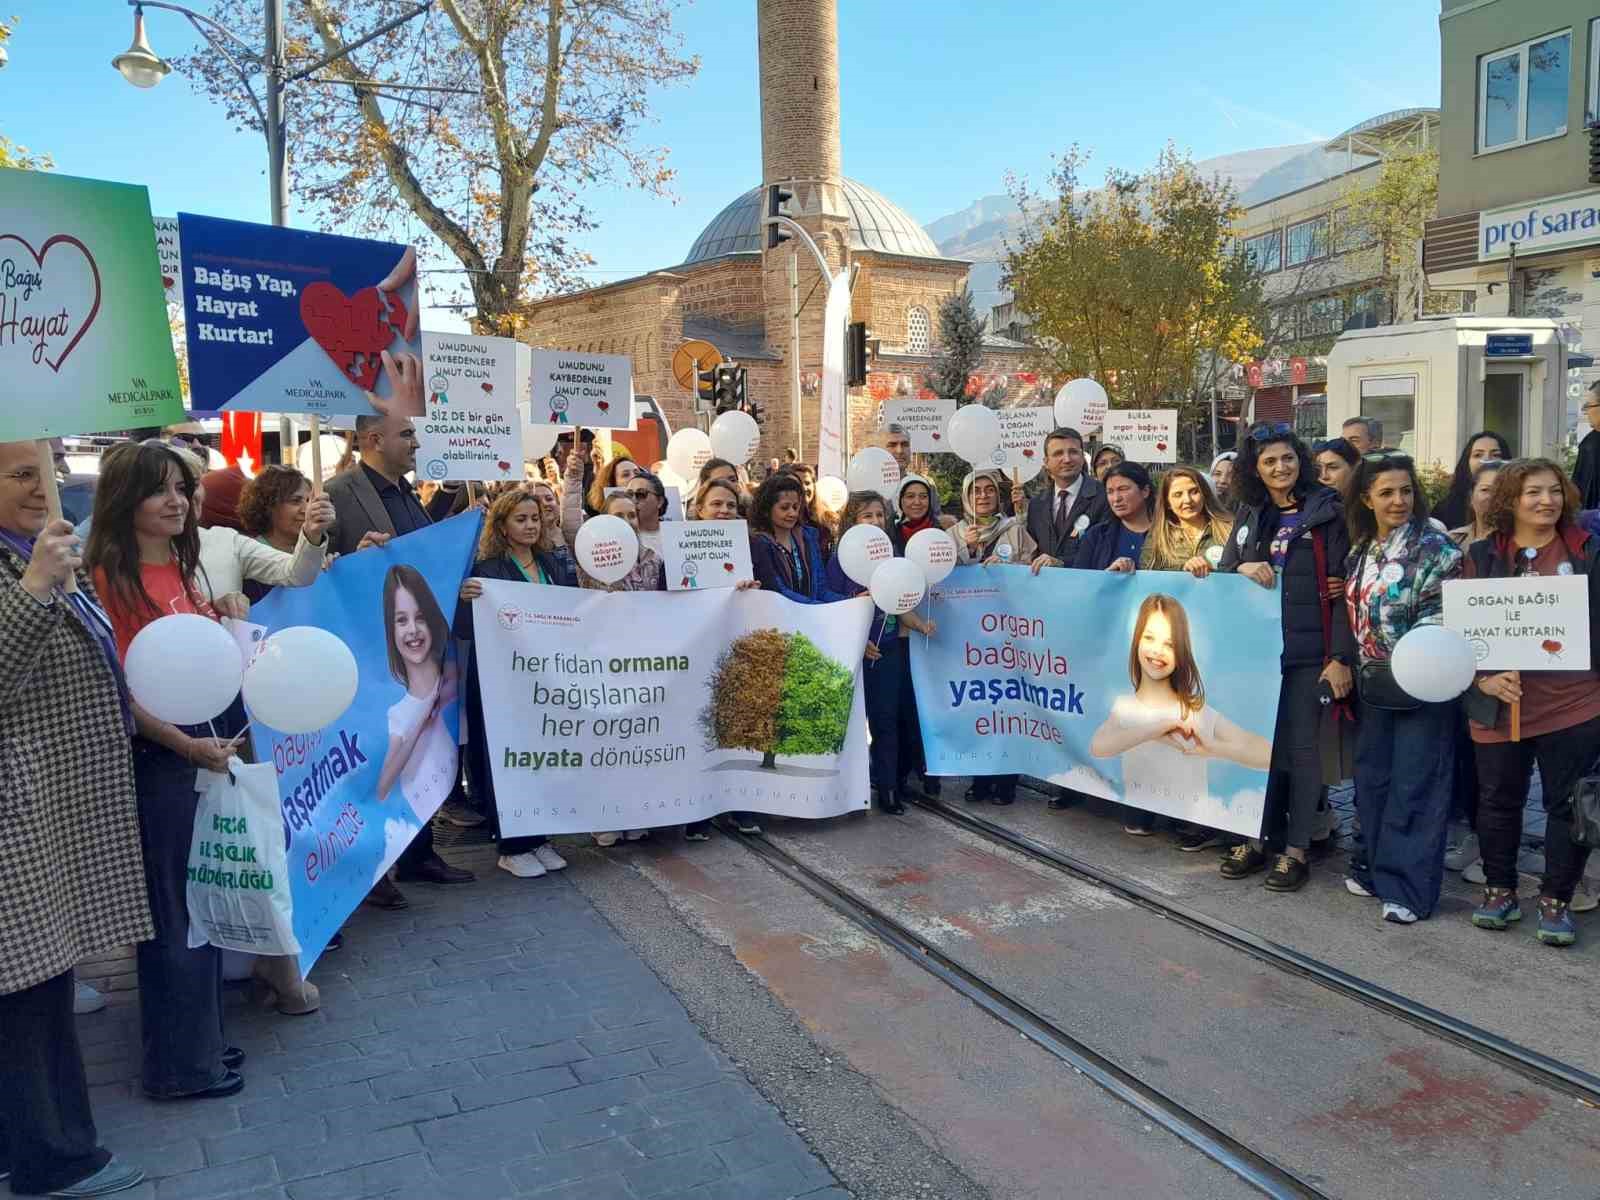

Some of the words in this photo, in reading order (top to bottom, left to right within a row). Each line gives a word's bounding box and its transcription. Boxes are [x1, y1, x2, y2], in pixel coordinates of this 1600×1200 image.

[1485, 209, 1538, 252] prof
[1542, 207, 1600, 236] sara
[2, 258, 42, 301] Bağış
[194, 266, 252, 294] Bağış
[256, 273, 297, 297] Yap,
[196, 294, 259, 319] Hayat
[198, 322, 274, 345] Kurtar!
[438, 342, 488, 353] UMUDUNU
[430, 354, 497, 366] KAYBEDENLERE
[558, 360, 606, 371] UMUDUNU
[436, 367, 462, 378] UMUT
[464, 369, 490, 378] OLUN
[549, 372, 613, 384] KAYBEDENLERE
[108, 389, 174, 403] MEDICALPARK
[285, 389, 347, 399] MEDICALPARK
[555, 386, 580, 395] UMUT
[582, 388, 606, 396] OLUN
[431, 409, 448, 421] SİZ
[451, 411, 465, 421] DE
[468, 411, 482, 421] bir
[485, 413, 504, 424] gün
[424, 424, 464, 434] ORGAN
[448, 438, 491, 448] MUHTAÇ
[684, 528, 726, 538] UMUDUNU
[678, 540, 733, 549] KAYBEDENLERE
[685, 551, 707, 561] UMUT
[708, 551, 731, 560] OLUN
[1467, 595, 1514, 606] ORGAN
[1518, 592, 1560, 606] BAĞIŞI
[1505, 608, 1520, 621] İLE
[981, 611, 1044, 640] organ
[1463, 627, 1500, 638] HAYAT
[1505, 626, 1565, 637] KURTARIN
[512, 650, 550, 672] her
[554, 652, 603, 674] fidan
[609, 655, 689, 672] ormana
[966, 641, 1068, 676] bağışıyla
[533, 682, 665, 709] bağışlanan
[950, 676, 1085, 714] yaşatmak
[542, 713, 585, 736] her
[593, 715, 659, 738] organ
[975, 711, 1062, 745] elinizde
[504, 747, 583, 770] hayata
[590, 744, 686, 768] dönüşsün
